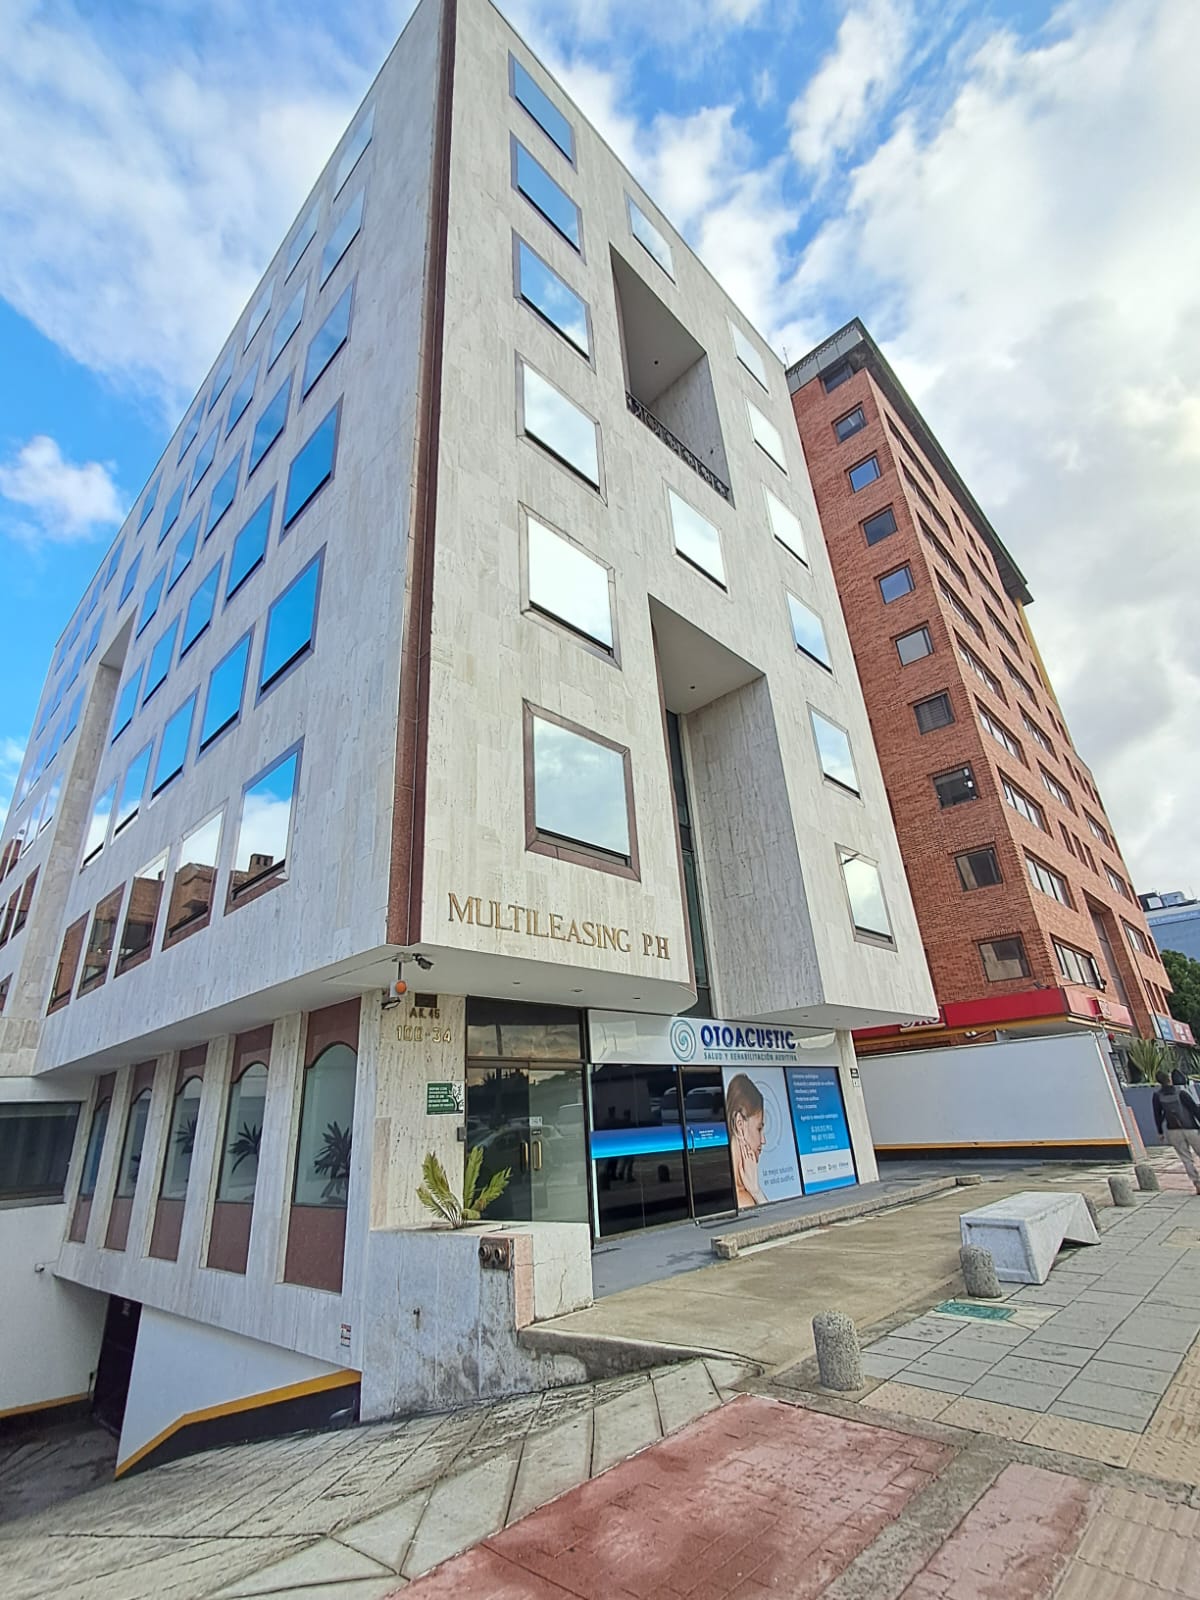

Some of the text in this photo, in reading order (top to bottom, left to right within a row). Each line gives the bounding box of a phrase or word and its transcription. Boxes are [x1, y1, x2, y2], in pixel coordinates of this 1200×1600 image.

[447, 892, 632, 953] MULTILEASING
[700, 1024, 797, 1050] OTOACUSTIC
[703, 1051, 723, 1061] SALUD
